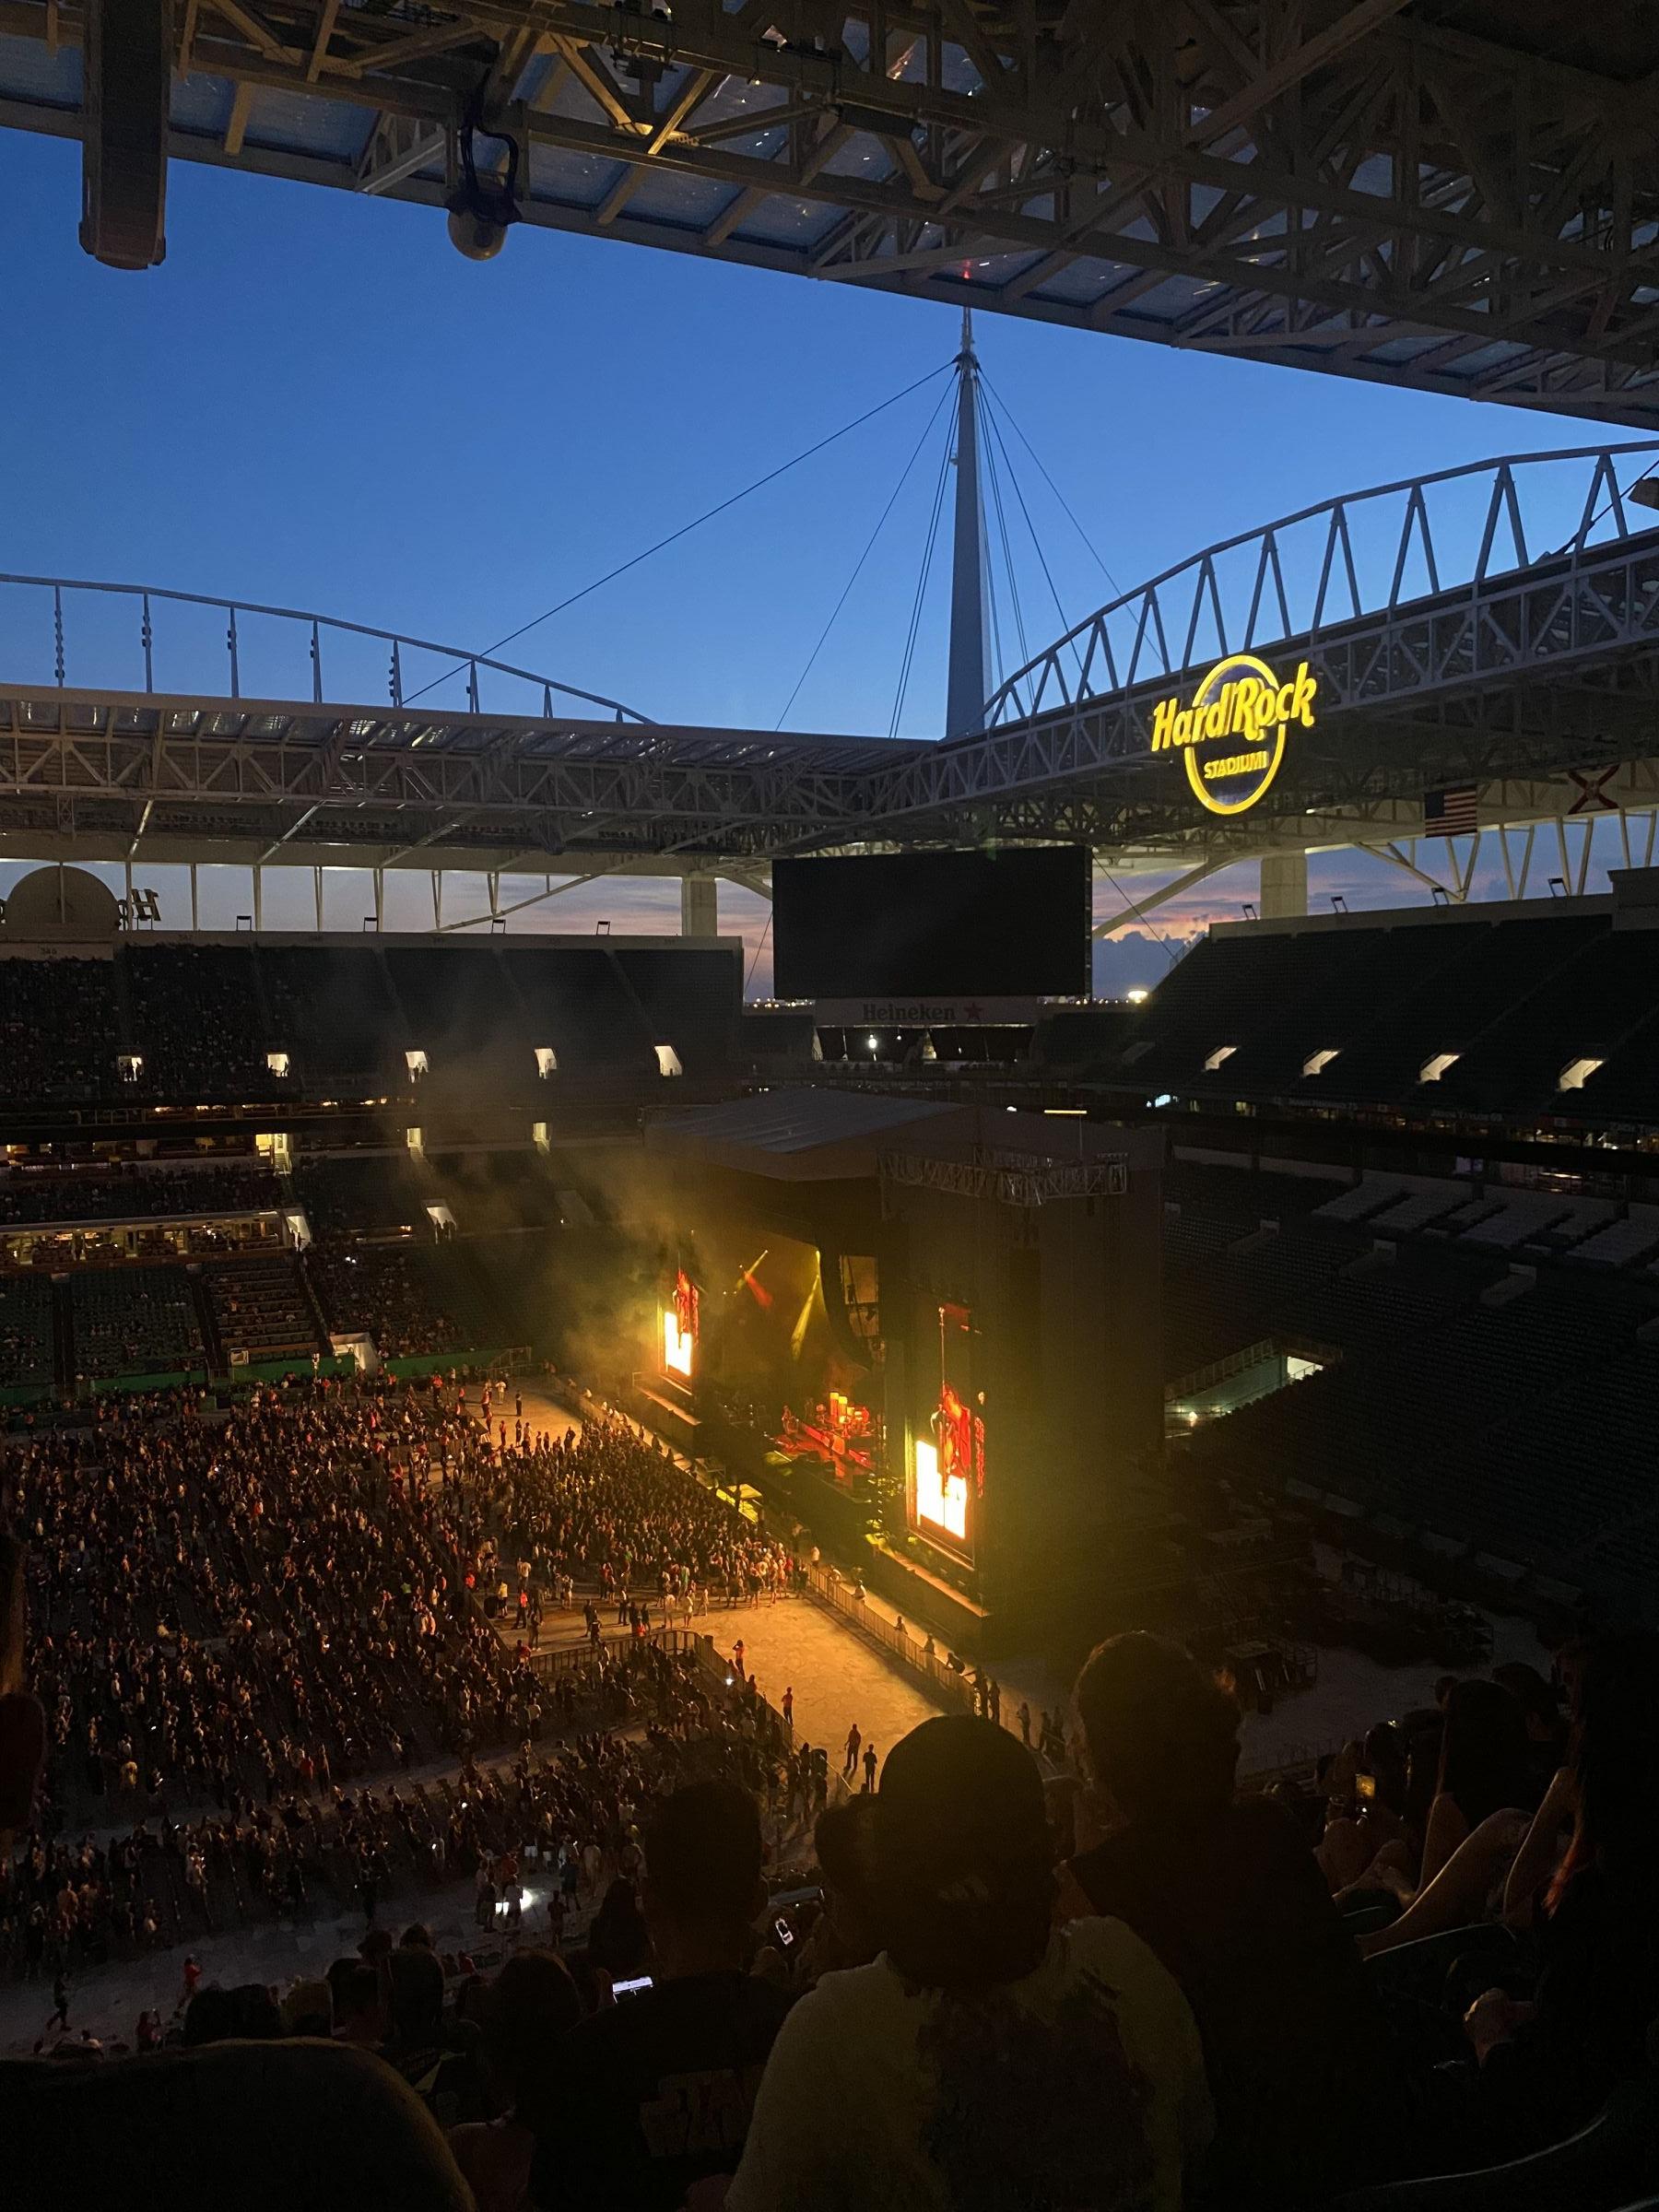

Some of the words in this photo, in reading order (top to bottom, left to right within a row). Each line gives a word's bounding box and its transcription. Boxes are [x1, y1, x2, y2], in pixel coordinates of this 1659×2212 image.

[1151, 683, 1231, 752] Hard
[1232, 662, 1317, 742] Rock
[1204, 750, 1268, 779] STADIUM
[863, 1004, 956, 1020] Heineken
